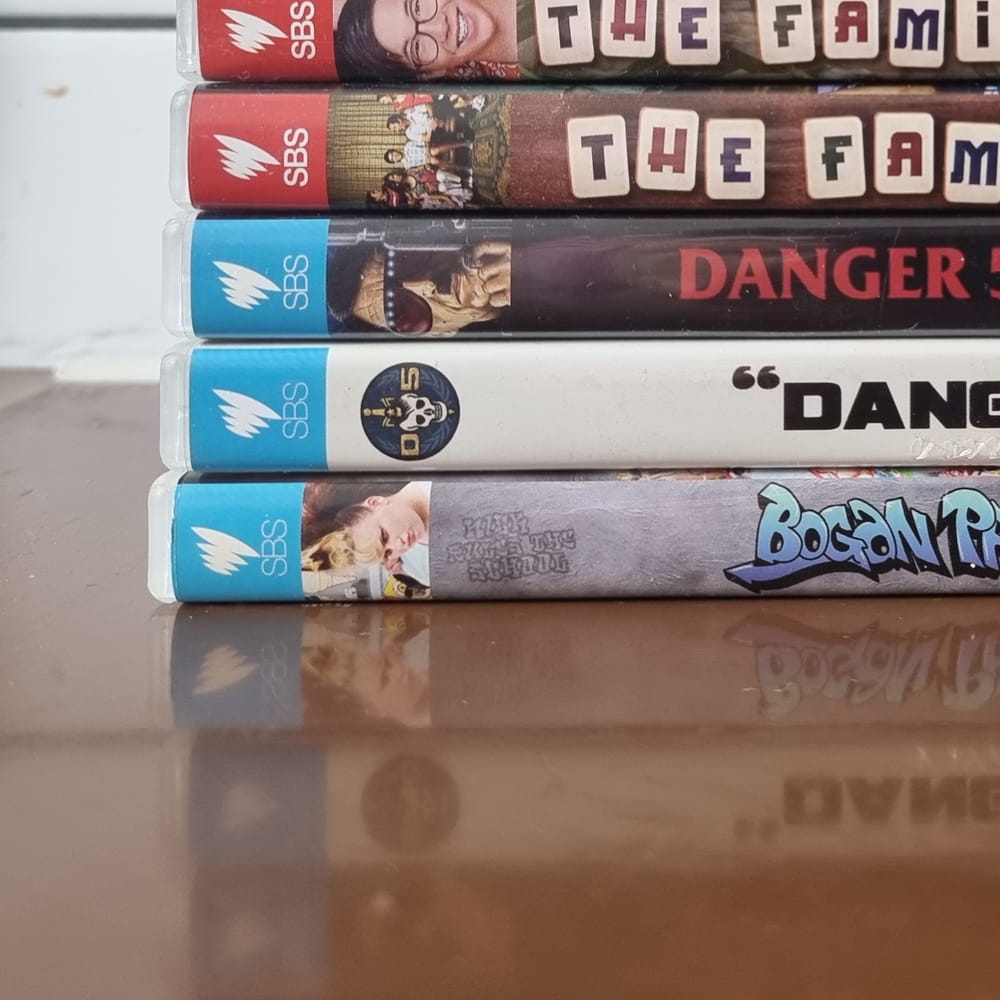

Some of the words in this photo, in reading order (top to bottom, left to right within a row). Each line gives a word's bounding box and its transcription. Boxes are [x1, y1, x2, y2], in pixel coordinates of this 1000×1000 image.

[290, 0, 317, 60] SBS
[283, 127, 310, 187] SBS
[576, 123, 755, 185] THE
[282, 254, 309, 310] SBS
[679, 246, 971, 300] DANGER
[282, 381, 309, 440] SBS
[261, 518, 288, 577] SBS
